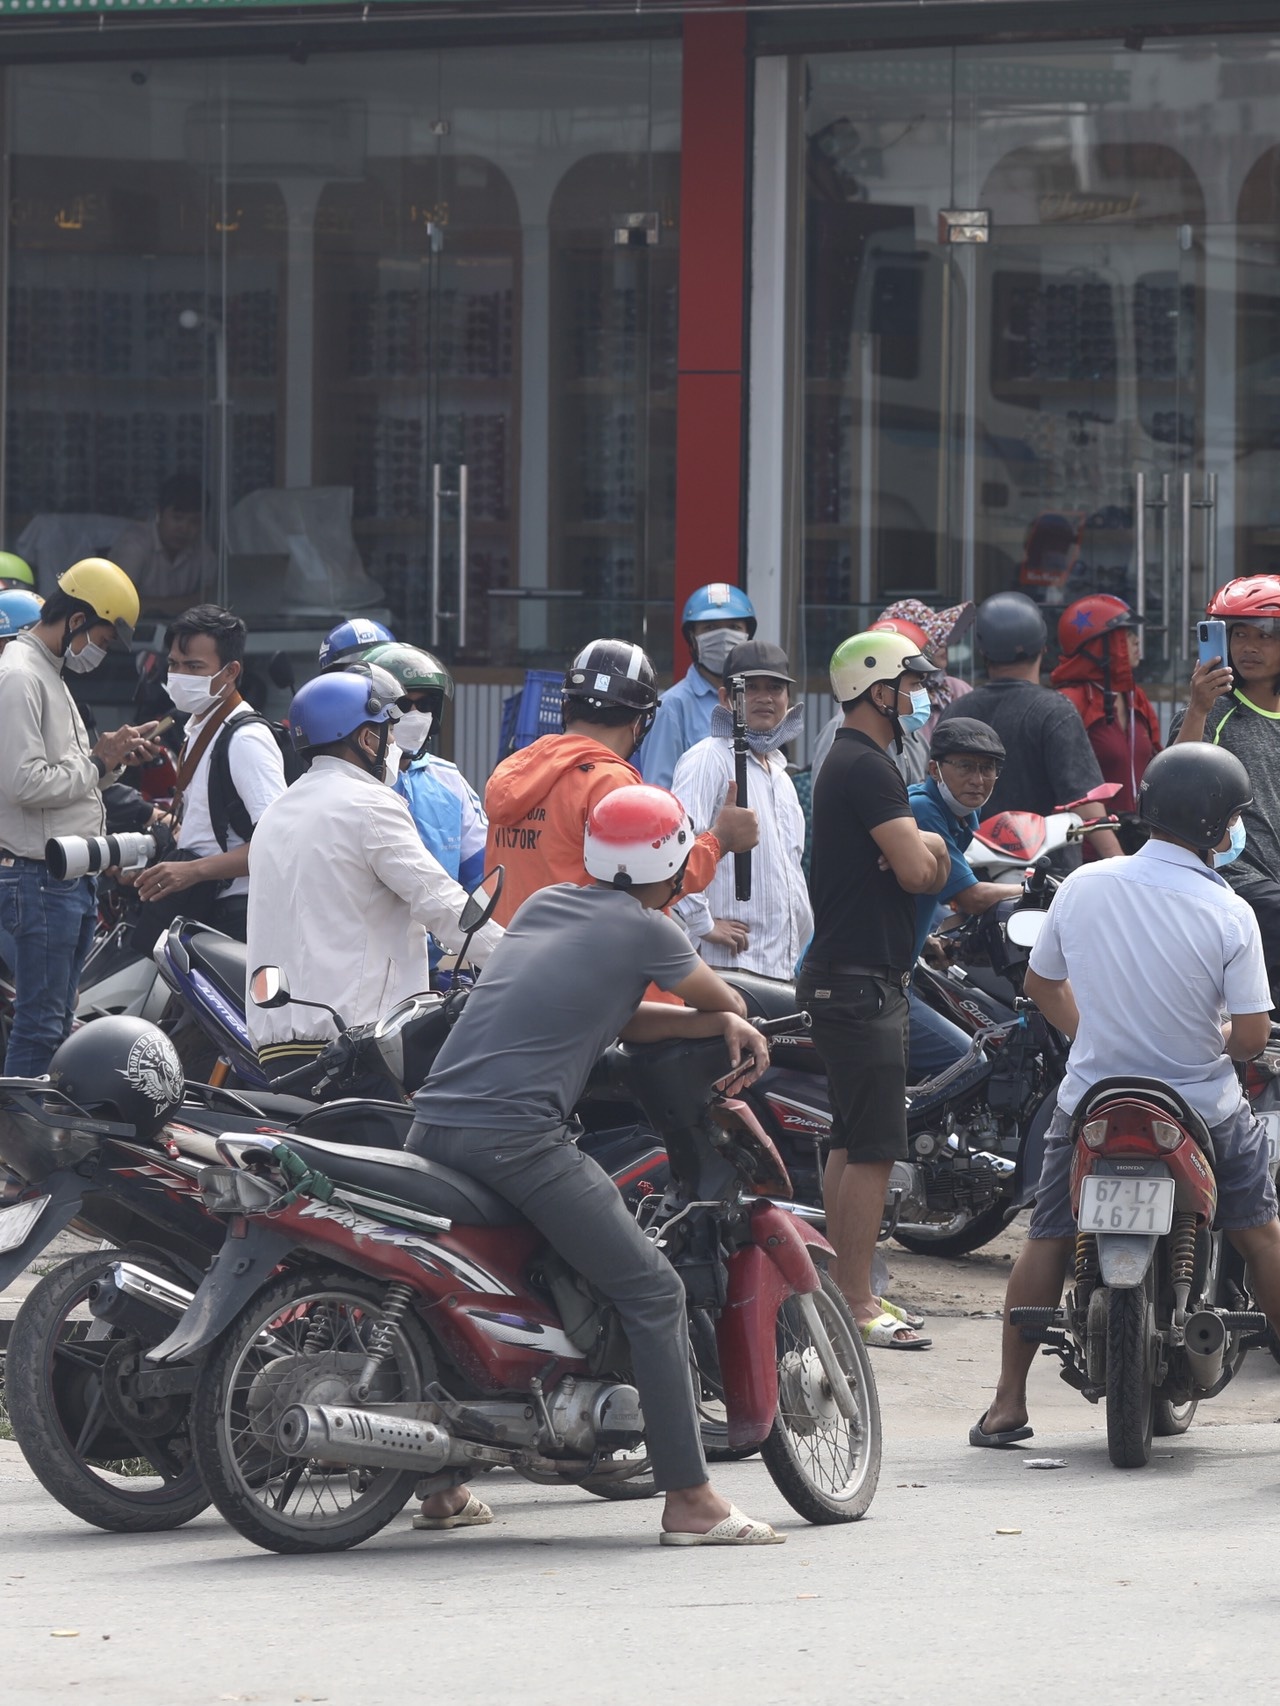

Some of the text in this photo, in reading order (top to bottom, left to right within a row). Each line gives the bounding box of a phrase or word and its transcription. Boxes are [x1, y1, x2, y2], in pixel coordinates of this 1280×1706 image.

[522, 807, 546, 821] OUR
[129, 1047, 142, 1073] BORN
[137, 1037, 148, 1049] TO
[145, 1046, 157, 1059] 66
[783, 1115, 831, 1130] Dream
[1092, 1205, 1155, 1230] 4671
